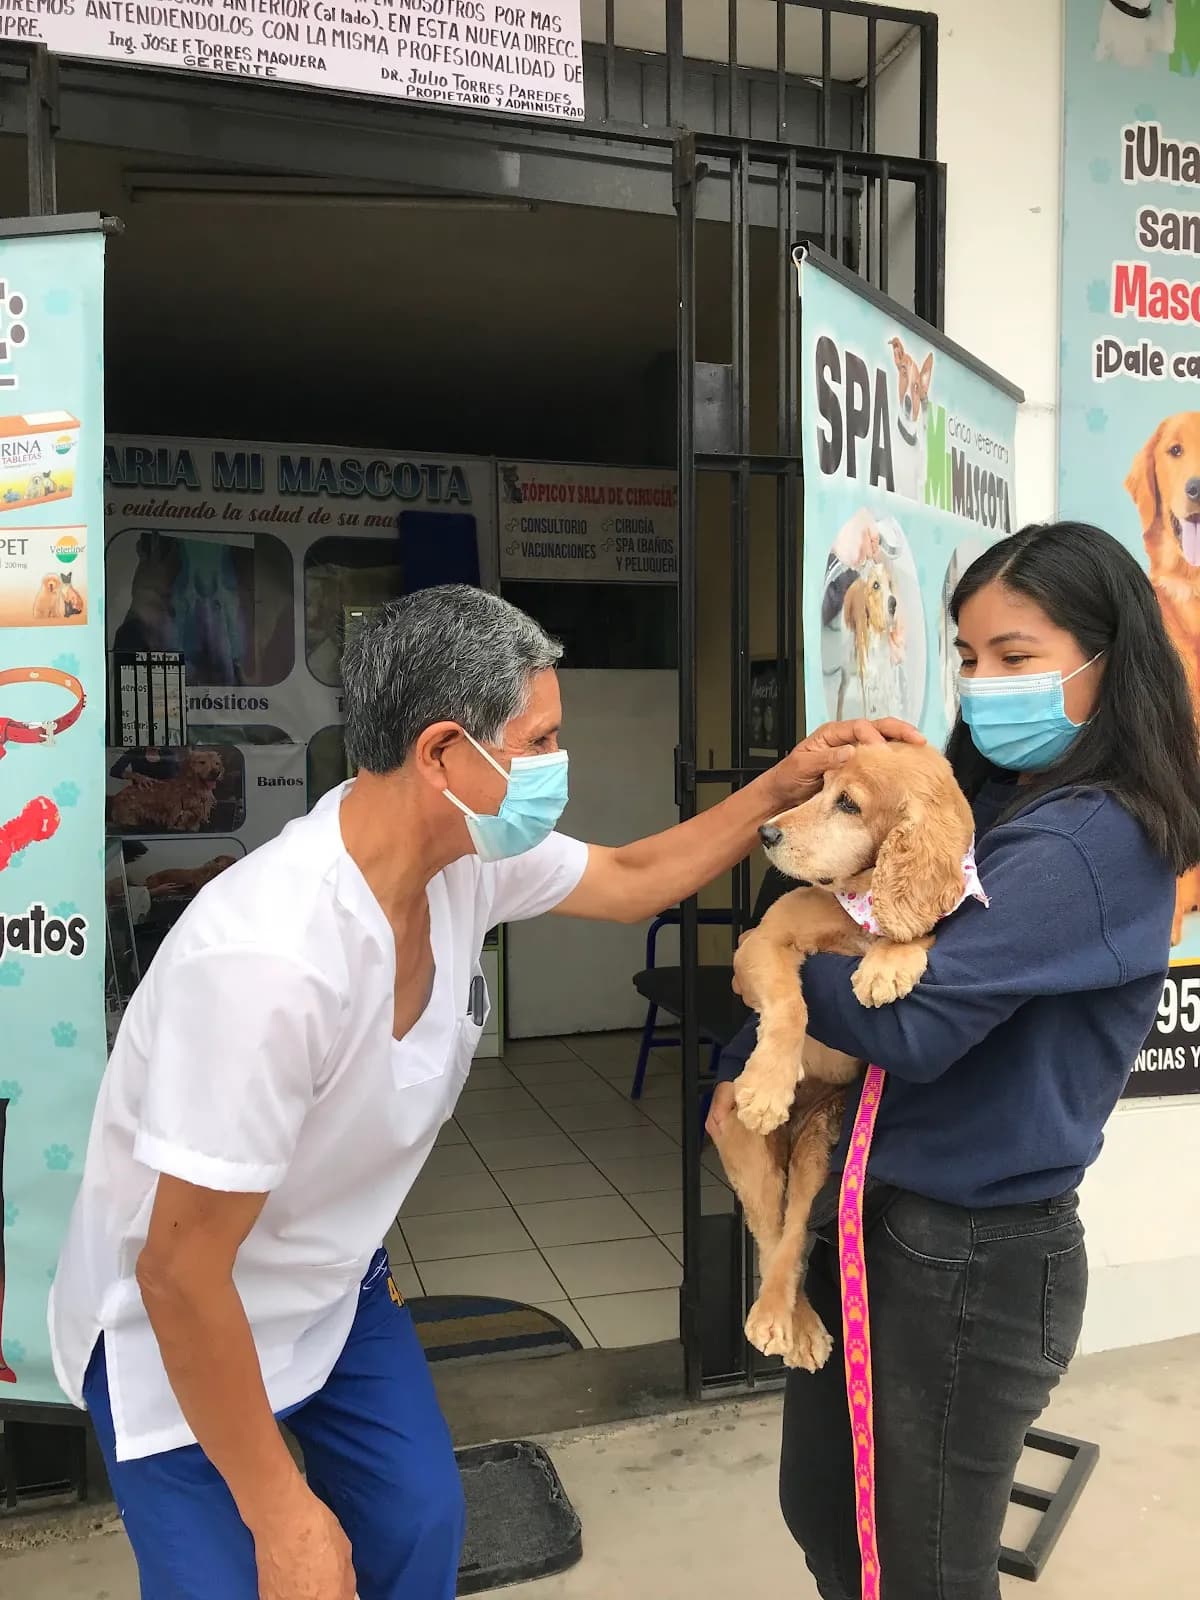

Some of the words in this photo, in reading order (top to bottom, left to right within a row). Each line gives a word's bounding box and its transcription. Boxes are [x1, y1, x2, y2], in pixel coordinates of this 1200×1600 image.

[0, 16, 43, 38] PRE.
[495, 6, 526, 28] POR
[531, 11, 562, 33] MAS
[85, 1, 254, 37] ANTENDIENDOLOS
[262, 20, 299, 42] CON
[306, 25, 327, 46] LA
[331, 29, 389, 56] MISMA
[397, 39, 555, 79] PROFESIONALIDAD
[564, 63, 583, 84] DE
[388, 13, 411, 34] EN
[417, 18, 459, 41] ESTA
[465, 26, 521, 51] NUEVA
[524, 34, 579, 59] DIRECC.
[107, 31, 138, 54] Ing.
[140, 34, 178, 53] JOSE
[195, 39, 252, 61] TORRES
[257, 48, 327, 72] MAQUERA
[184, 56, 277, 77] GERENTE
[406, 85, 490, 105] PROPIETARIO
[453, 73, 505, 96] TORRES
[509, 83, 572, 106] PAREDES
[815, 336, 895, 492] SPA
[212, 450, 264, 492] MI
[278, 454, 472, 504] MASCOTA
[578, 487, 606, 504] SALA
[122, 499, 216, 520] cuidando
[222, 502, 242, 521] la
[249, 505, 304, 524] salud
[308, 507, 331, 525] de
[337, 512, 360, 526] su
[521, 517, 587, 534] CONSULTORIO
[615, 516, 655, 534] CIRUGÍA
[521, 542, 597, 559] VACUNACIONES
[615, 539, 635, 552] SPA
[257, 776, 304, 788] Baños
